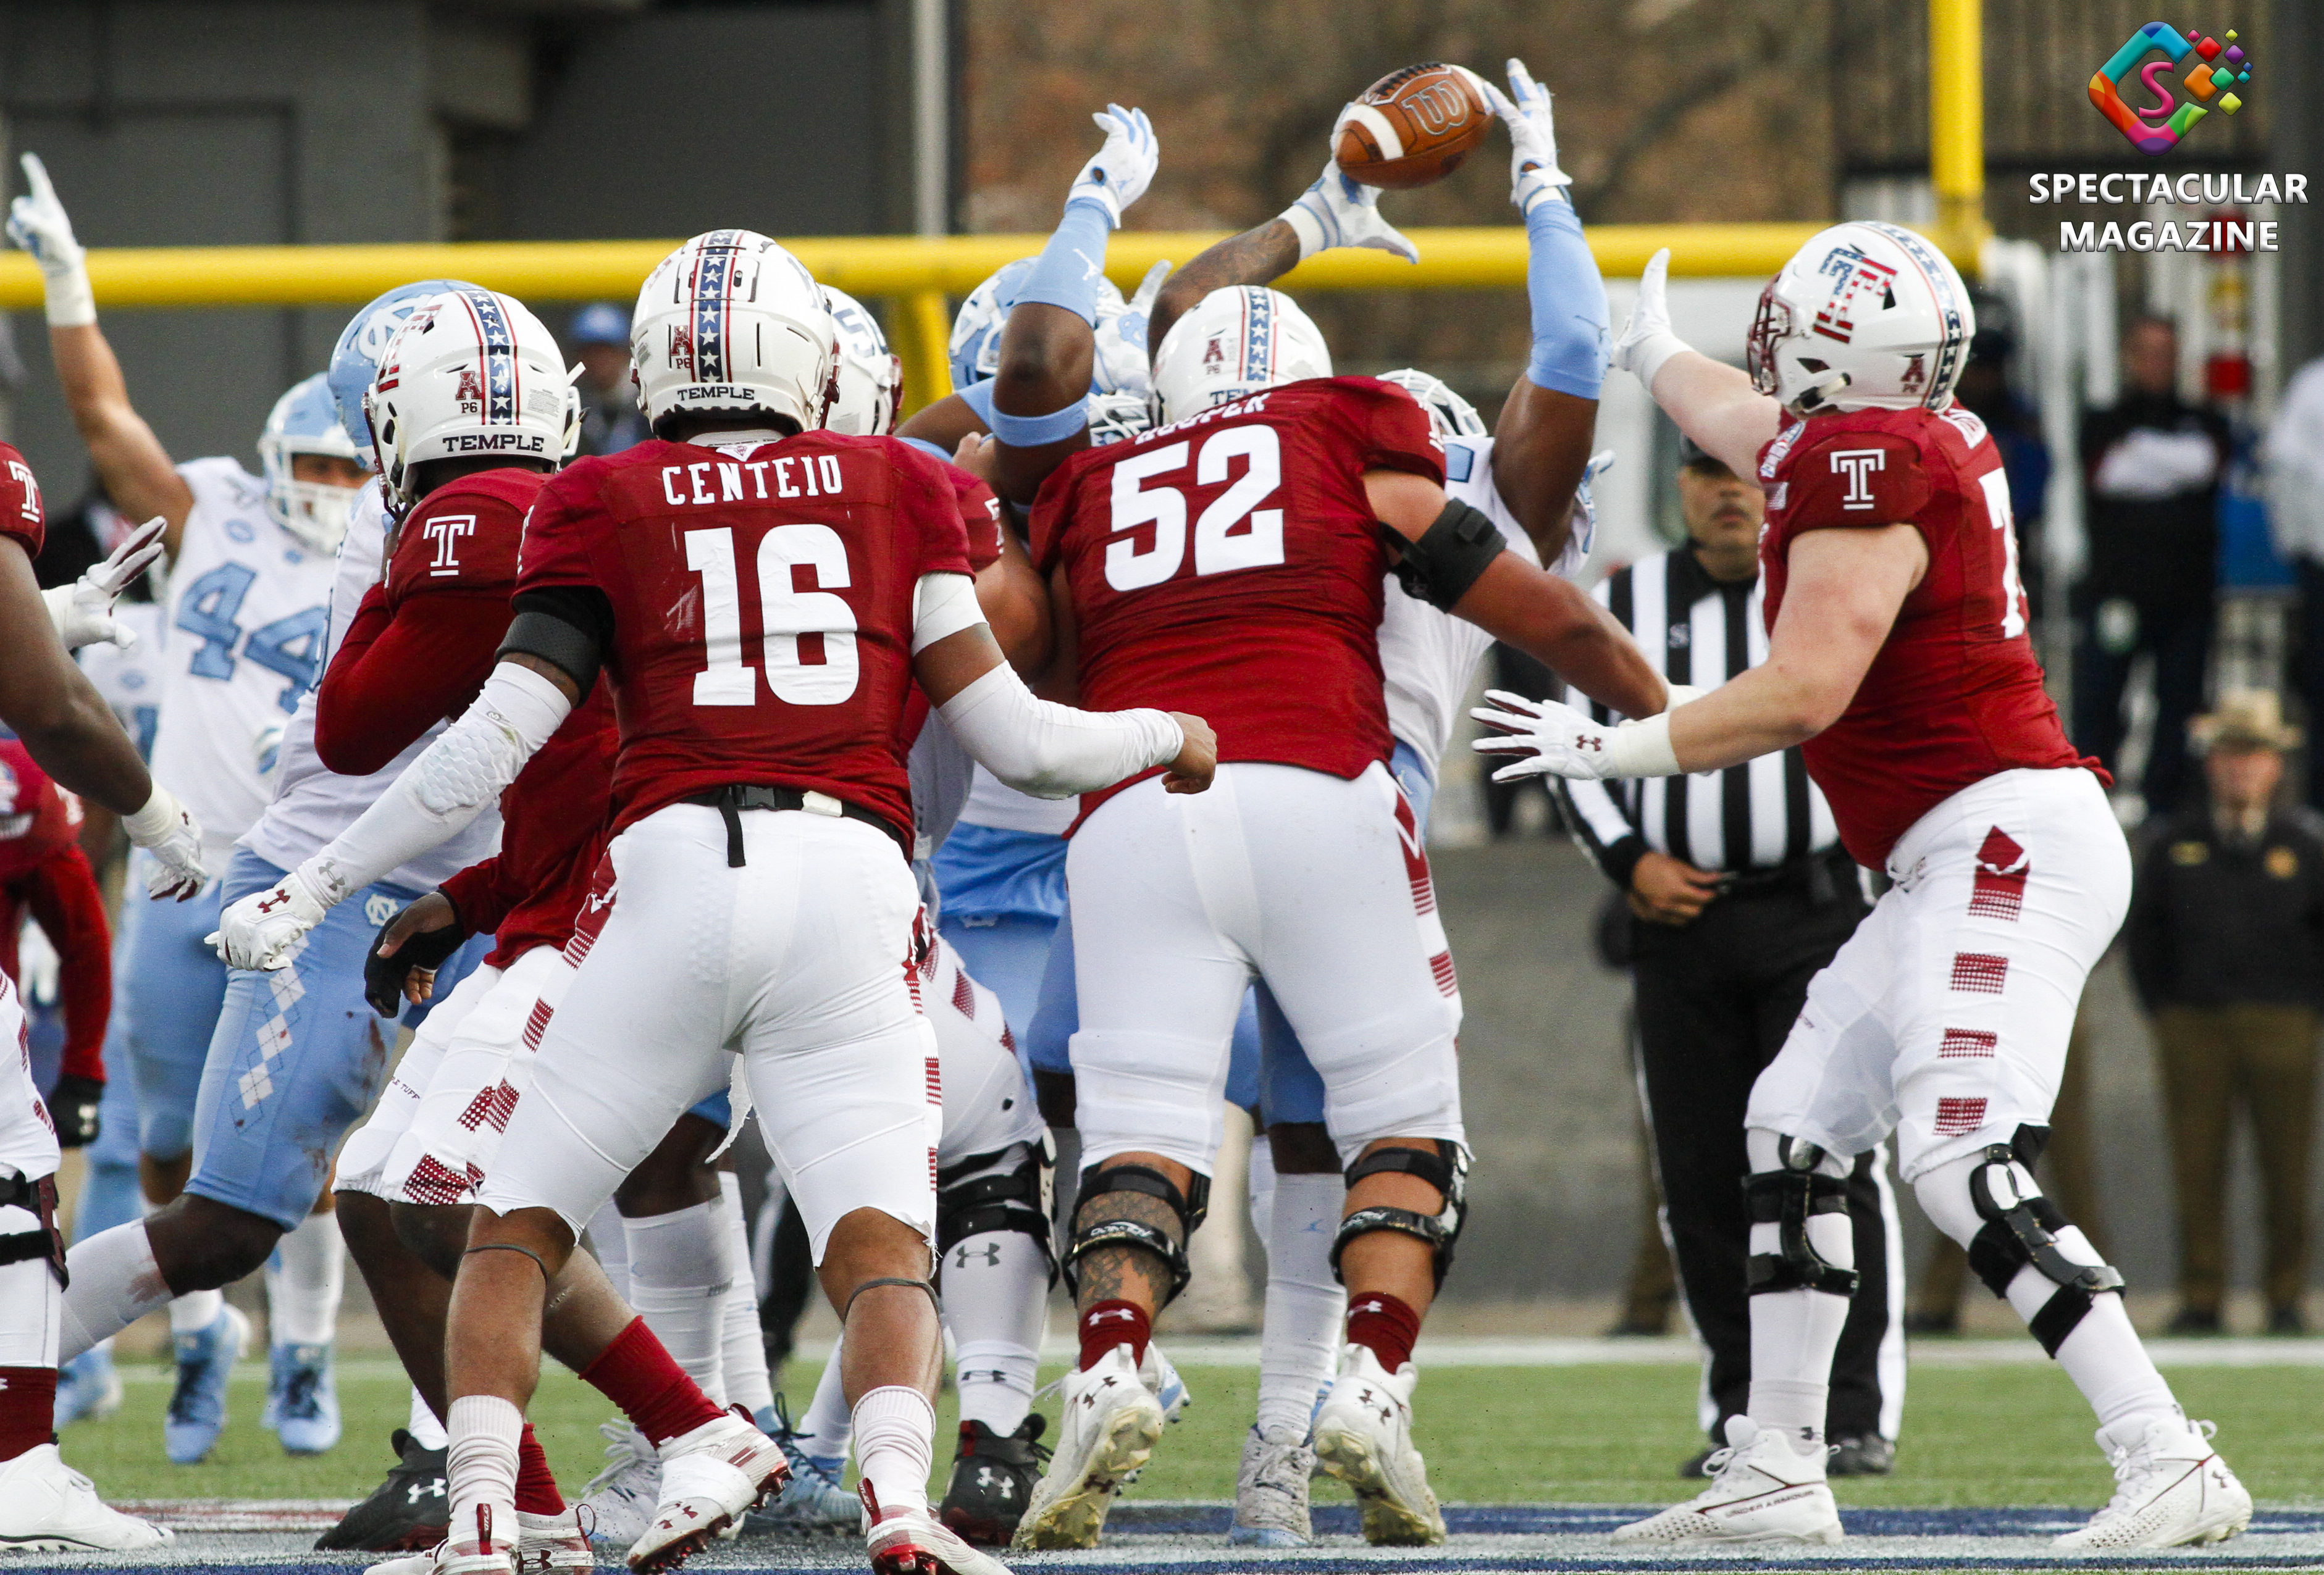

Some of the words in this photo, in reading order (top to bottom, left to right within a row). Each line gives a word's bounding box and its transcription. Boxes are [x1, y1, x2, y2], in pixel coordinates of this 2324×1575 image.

[461, 403, 478, 414] P6
[677, 386, 755, 401] TEMPLE
[442, 435, 545, 453] TEMPLE
[661, 454, 843, 505] CENTEIO
[1104, 424, 1285, 593] 52
[684, 524, 860, 706] 16
[177, 561, 332, 714] 44
[400, 1084, 420, 1099] TUFF
